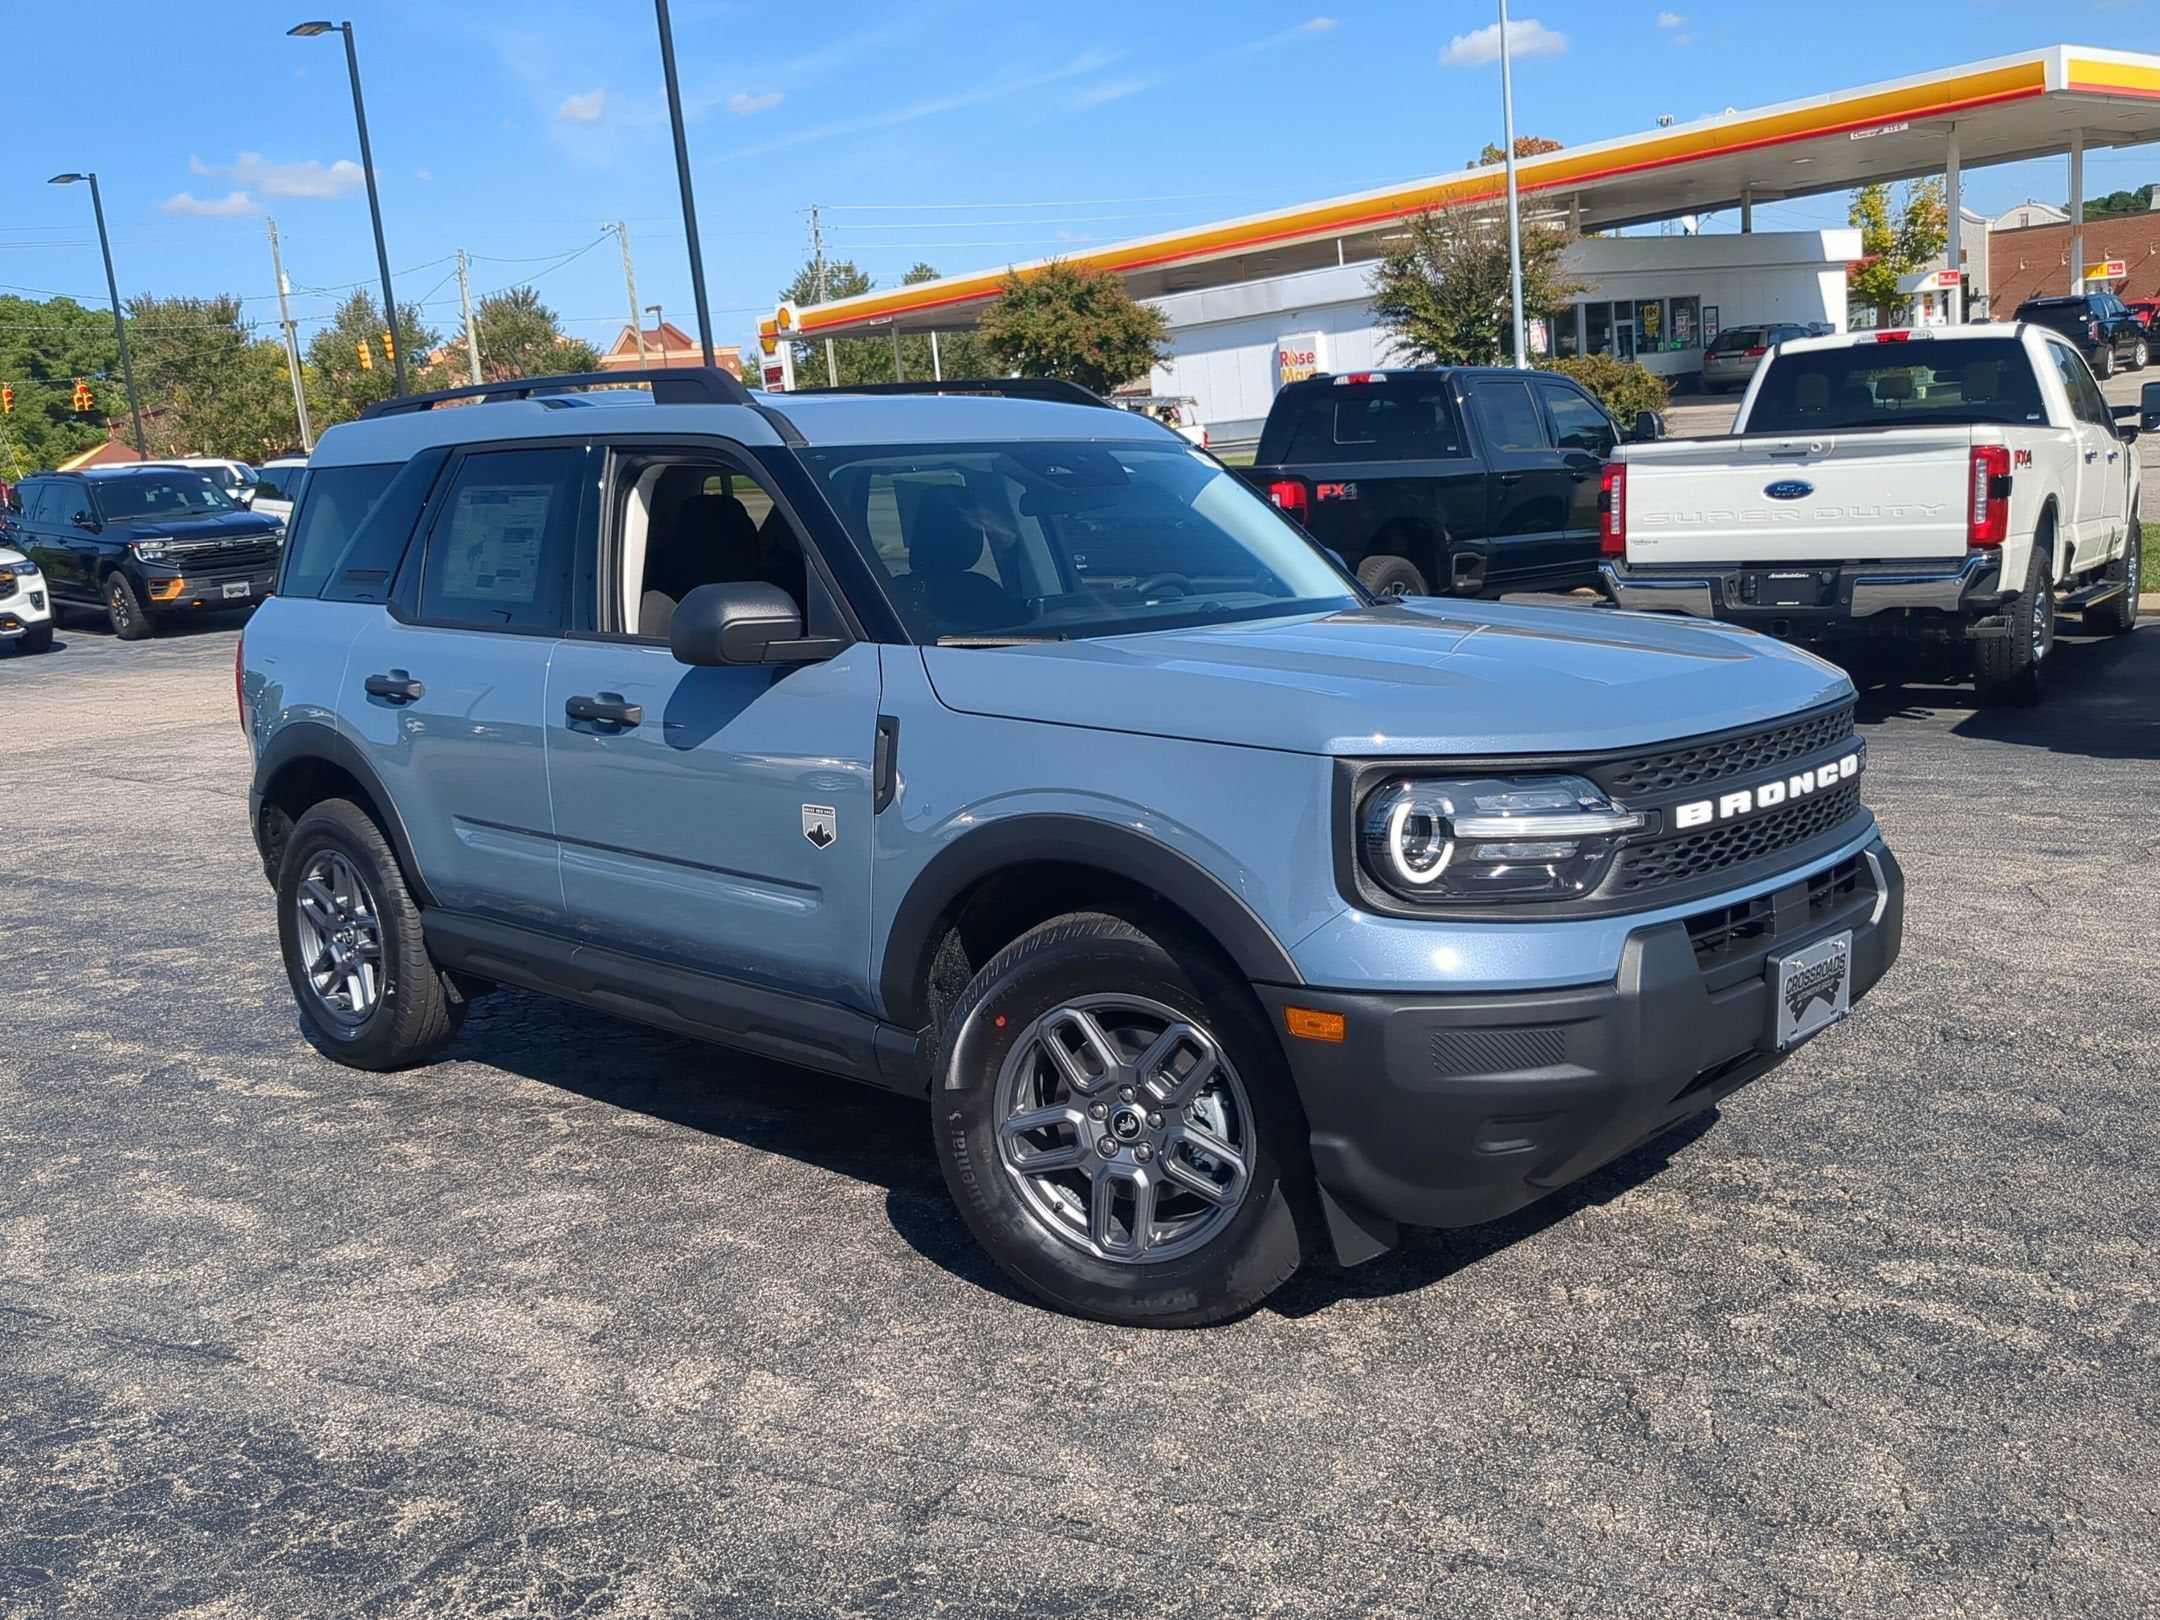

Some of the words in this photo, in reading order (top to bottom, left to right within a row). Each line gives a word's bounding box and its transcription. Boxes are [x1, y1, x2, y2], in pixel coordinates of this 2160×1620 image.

[1280, 349, 1315, 367] Rose
[1281, 366, 1317, 384] Mar
[2014, 449, 2032, 470] FX4
[1316, 482, 1358, 500] FX4
[1643, 507, 1800, 526] SUPER
[1813, 502, 1947, 520] DUTY
[1675, 753, 1859, 829] BRONCO
[1785, 953, 1846, 994] CROSSROADS
